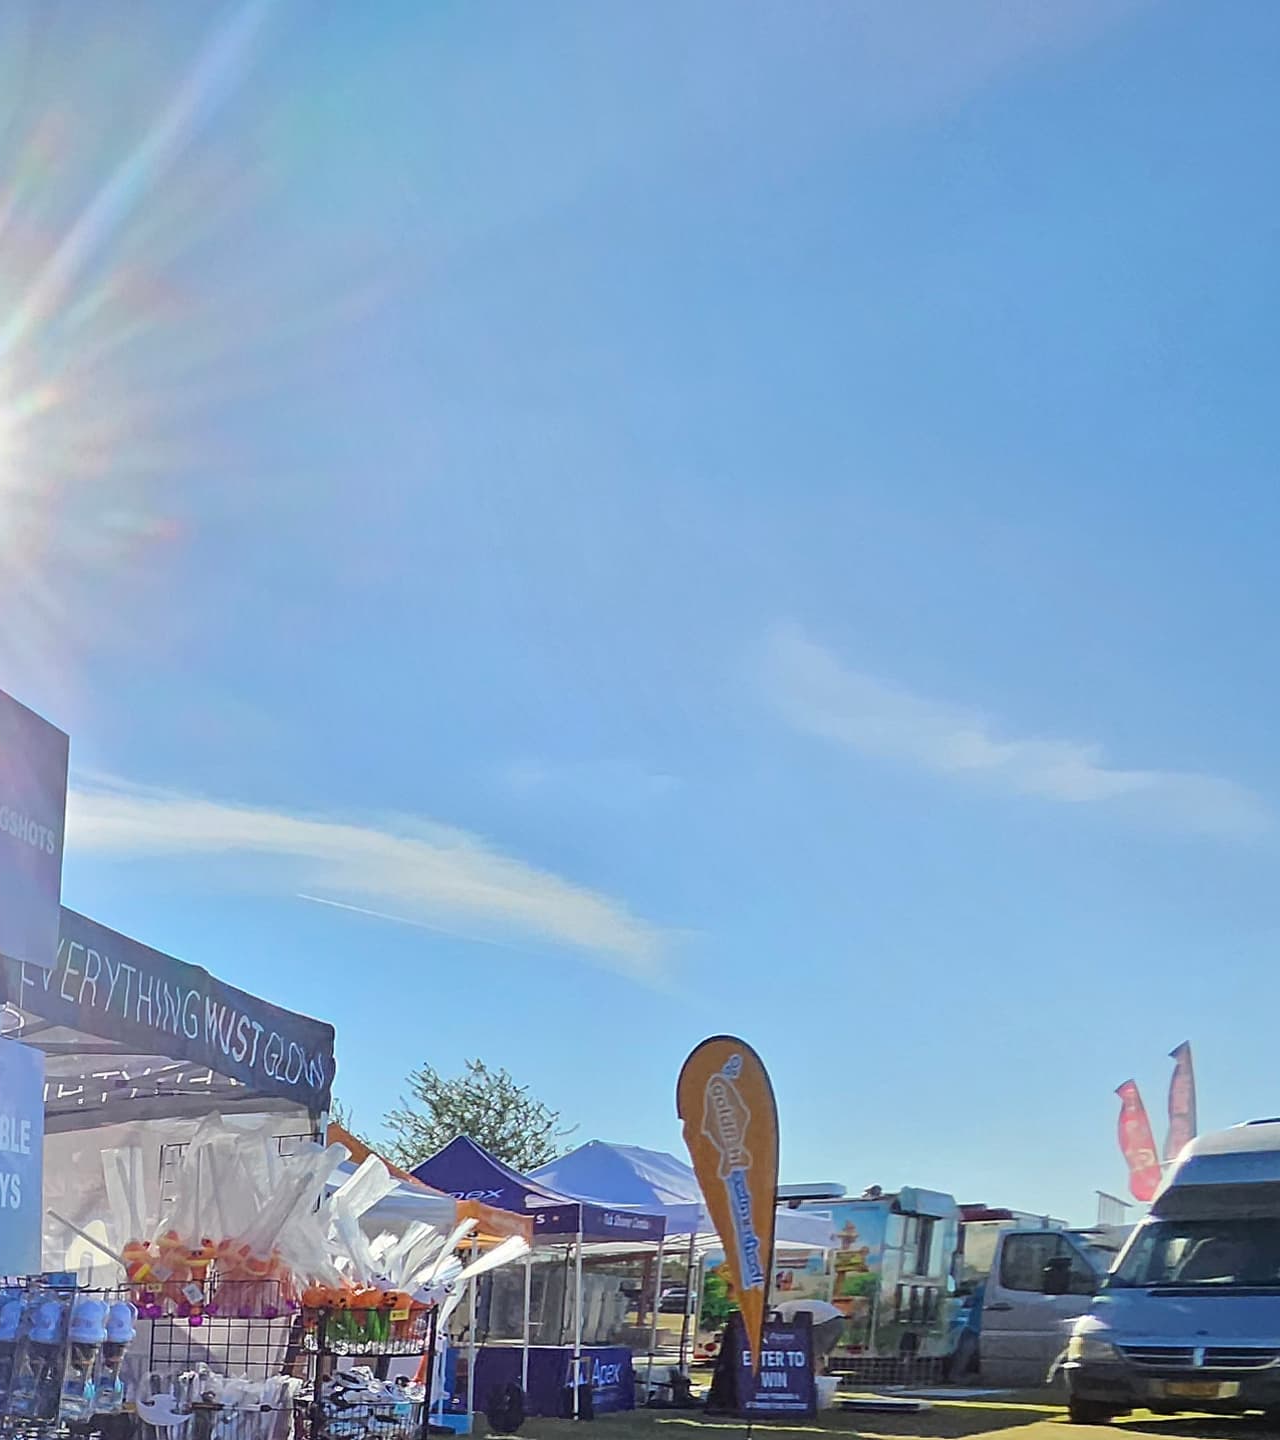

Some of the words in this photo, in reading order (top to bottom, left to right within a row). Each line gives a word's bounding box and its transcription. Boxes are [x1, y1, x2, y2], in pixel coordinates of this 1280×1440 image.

[205, 996, 265, 1067] MUST
[263, 1032, 325, 1089] GLOW
[742, 1350, 784, 1367] ETER
[786, 1351, 806, 1367] TO
[760, 1371, 788, 1388] WIN
